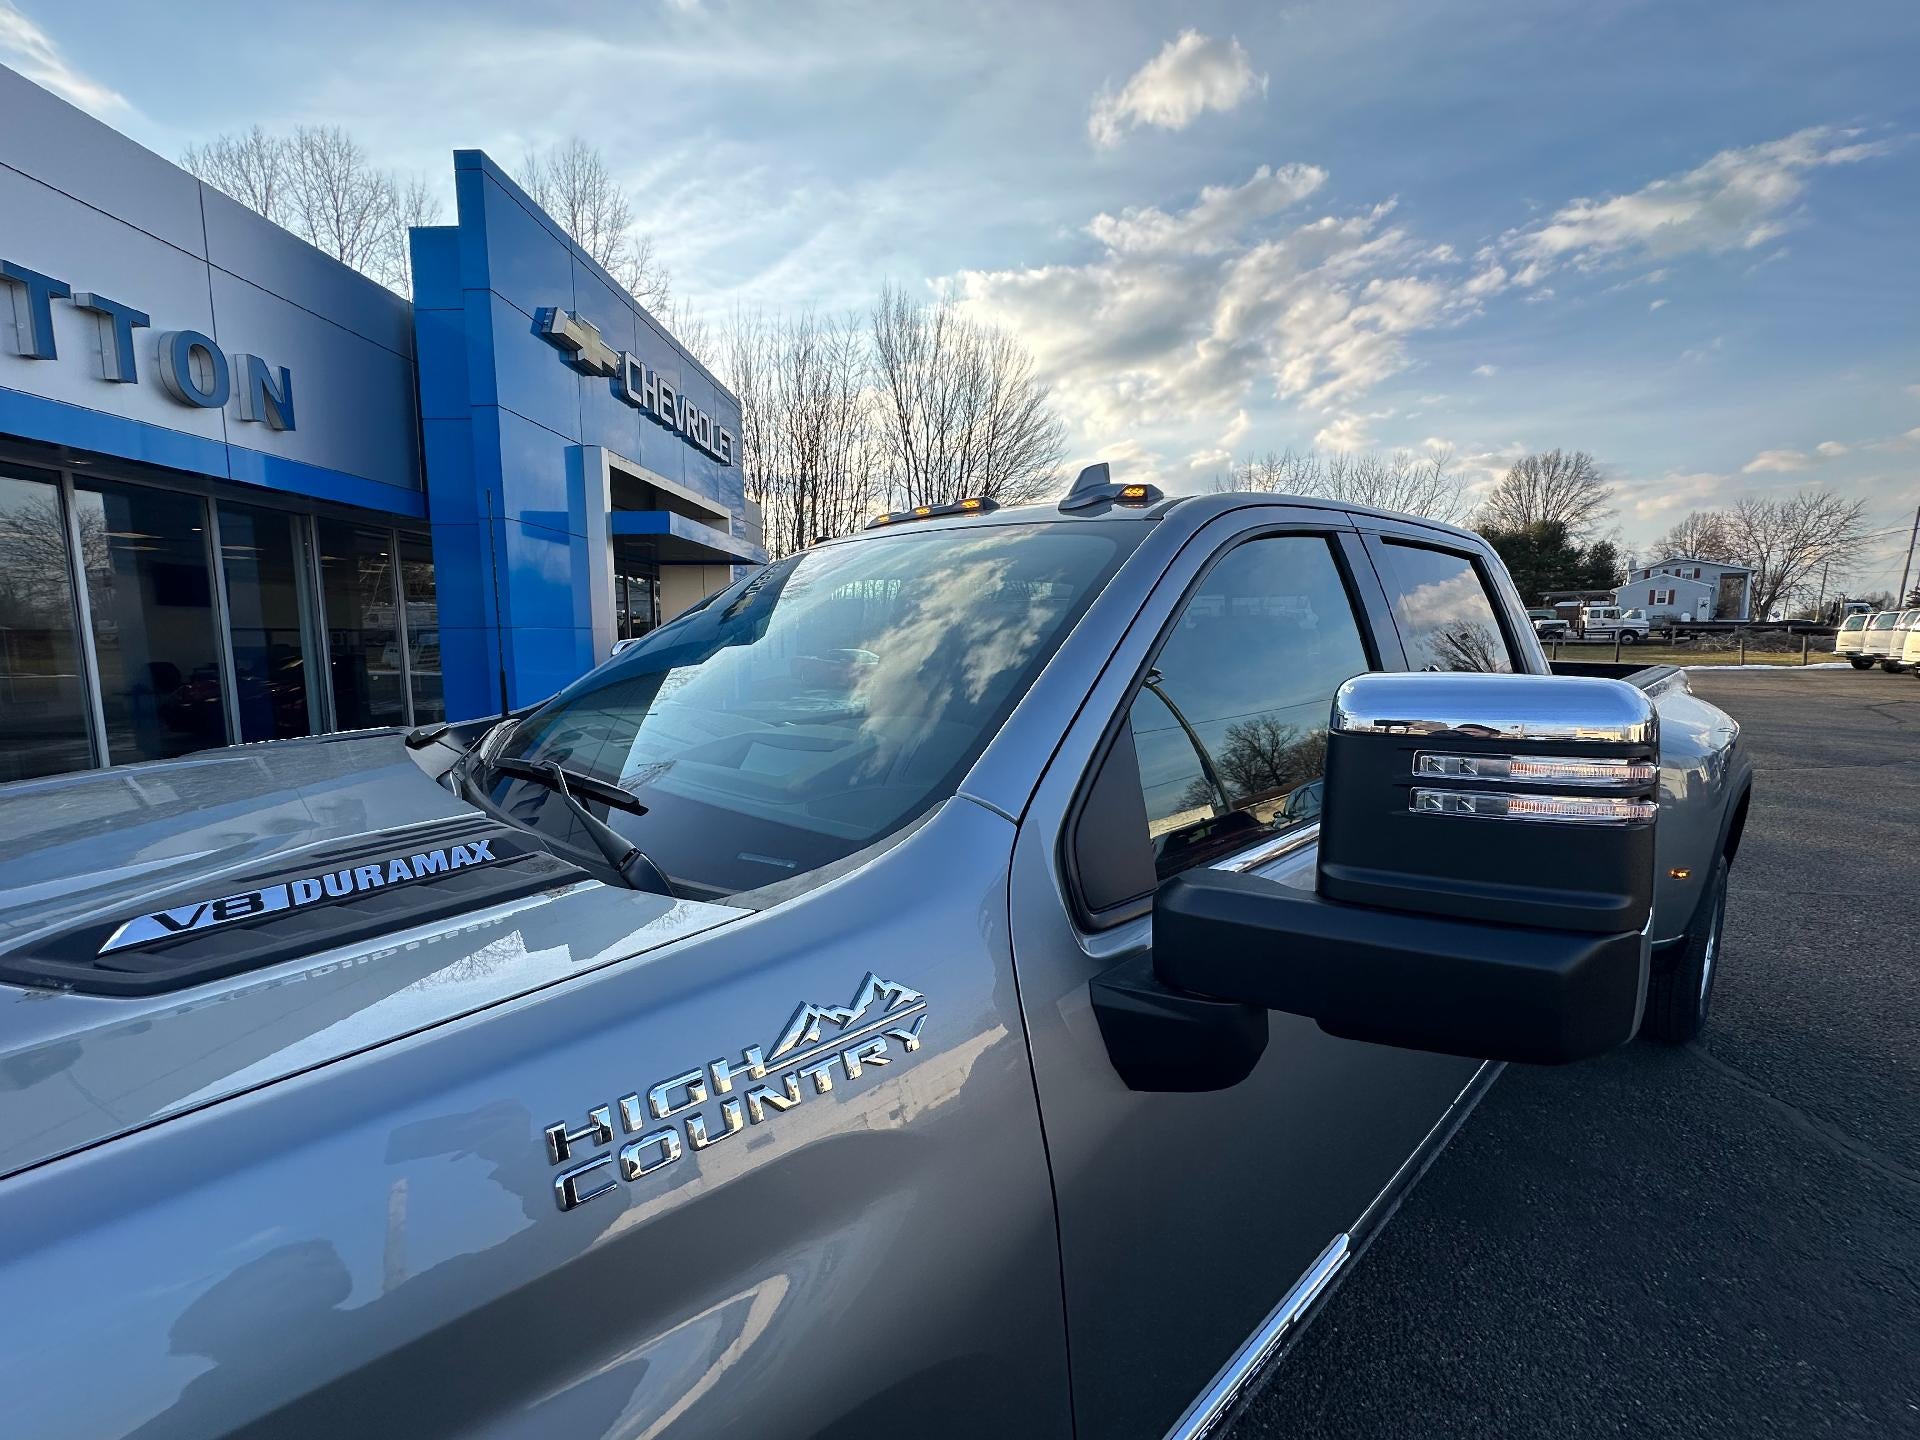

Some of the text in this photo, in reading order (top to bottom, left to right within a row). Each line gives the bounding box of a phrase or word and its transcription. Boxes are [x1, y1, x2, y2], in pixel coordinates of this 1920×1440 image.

[622, 350, 736, 467] CHEVROLET
[149, 839, 496, 932] V8 DURAMAX
[544, 1043, 768, 1166] HIGH
[553, 1014, 928, 1212] COUNTRY
